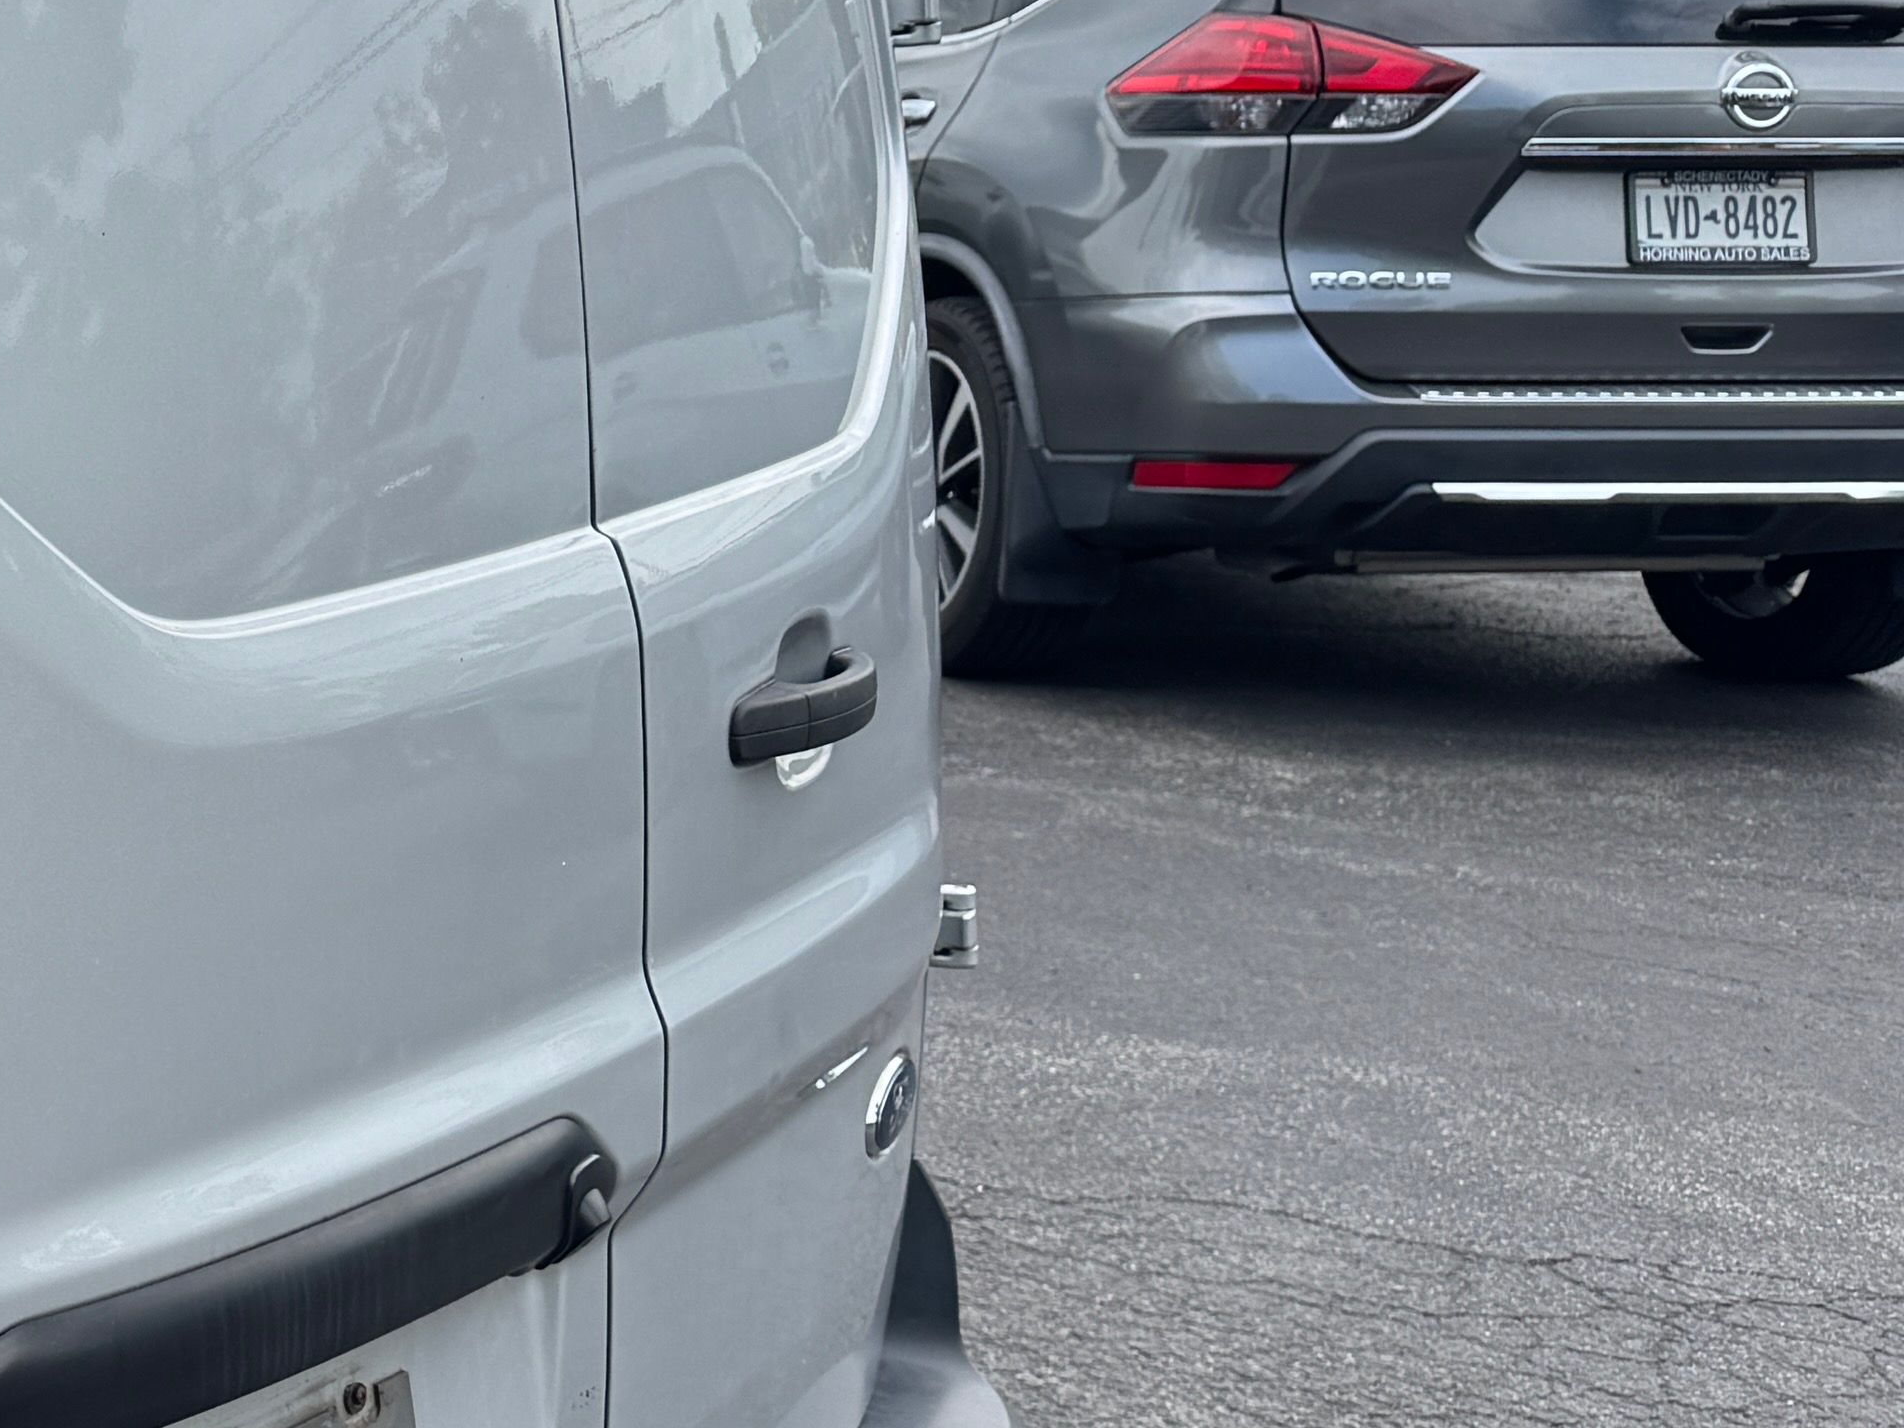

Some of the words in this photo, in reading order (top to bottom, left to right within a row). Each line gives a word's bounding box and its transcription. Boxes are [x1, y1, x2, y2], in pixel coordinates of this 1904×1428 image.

[1673, 170, 1768, 184] SCHENECTADY
[1639, 246, 1711, 262] HORNING
[1713, 246, 1757, 262] AUTO
[1760, 246, 1811, 262] SALES
[1309, 270, 1453, 290] ROGUE
